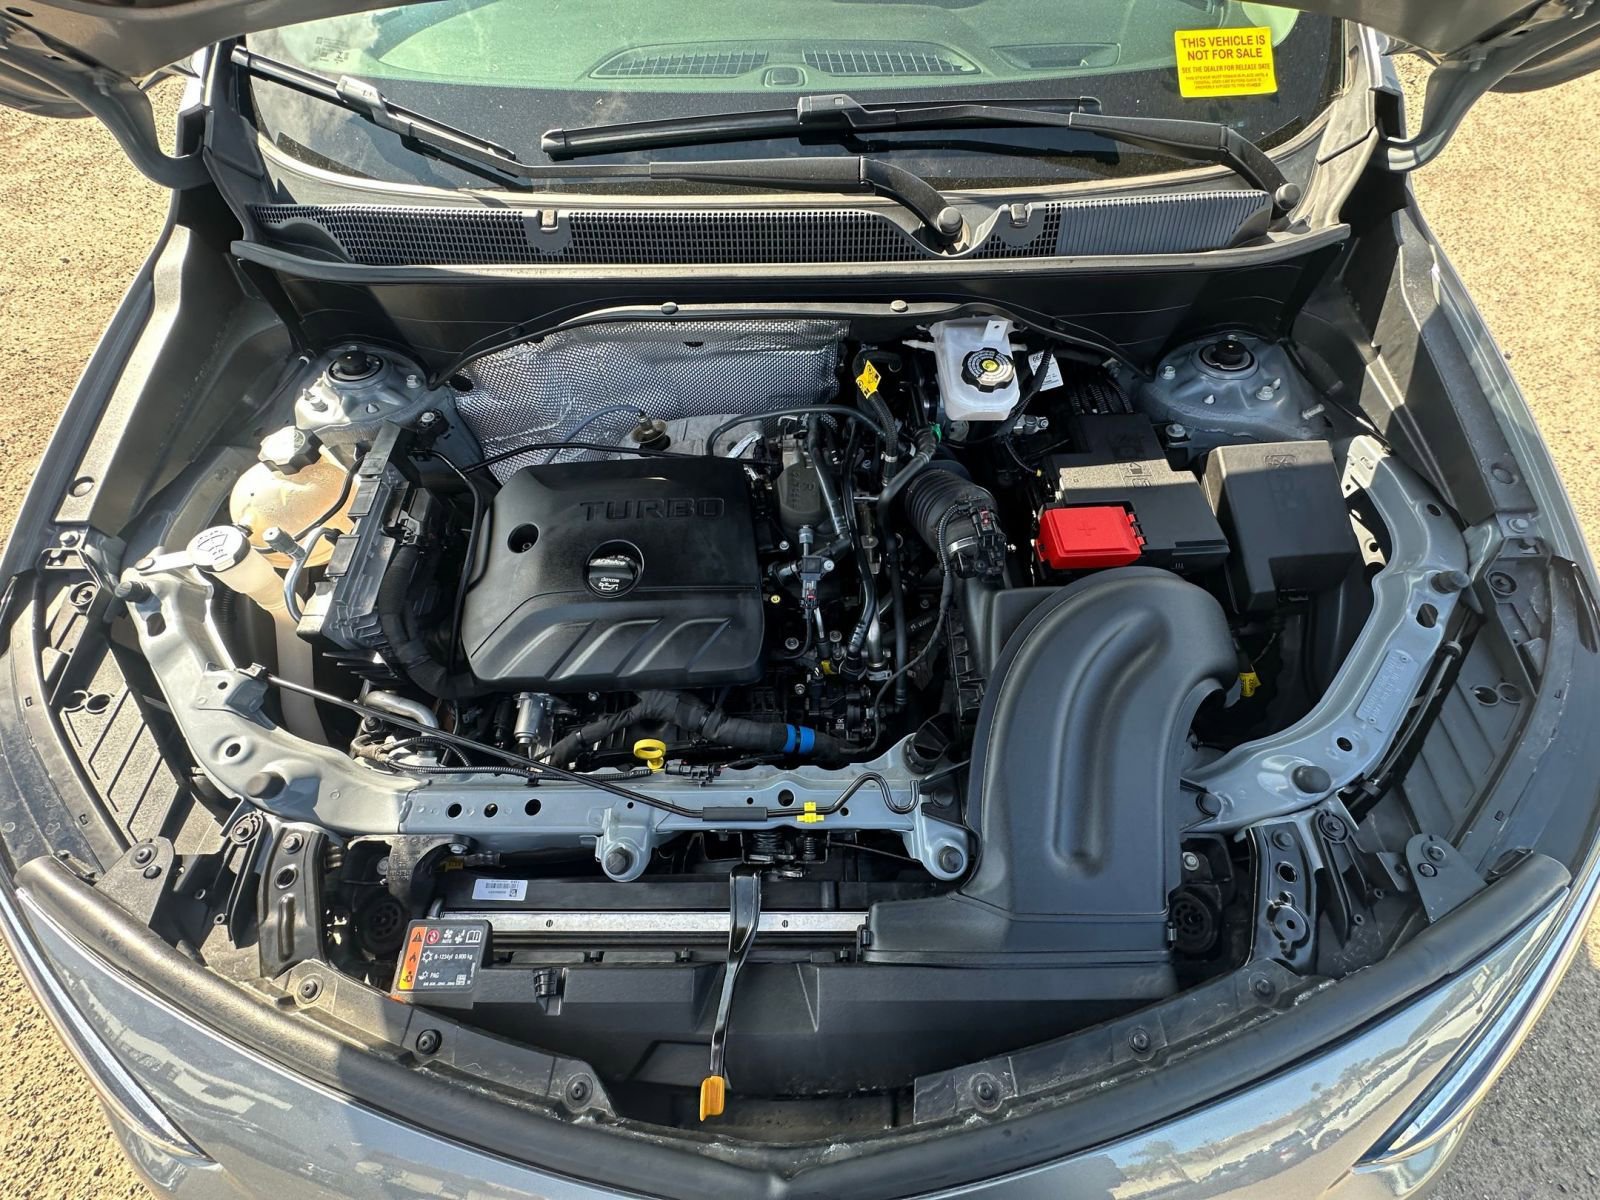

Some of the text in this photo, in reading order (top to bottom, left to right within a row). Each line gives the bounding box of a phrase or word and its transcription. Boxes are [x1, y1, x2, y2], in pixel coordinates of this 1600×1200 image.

[1181, 35, 1266, 48] THIS VEHICLE IS
[1187, 48, 1263, 60] NOT FOR SALE
[580, 497, 725, 521] TURBO
